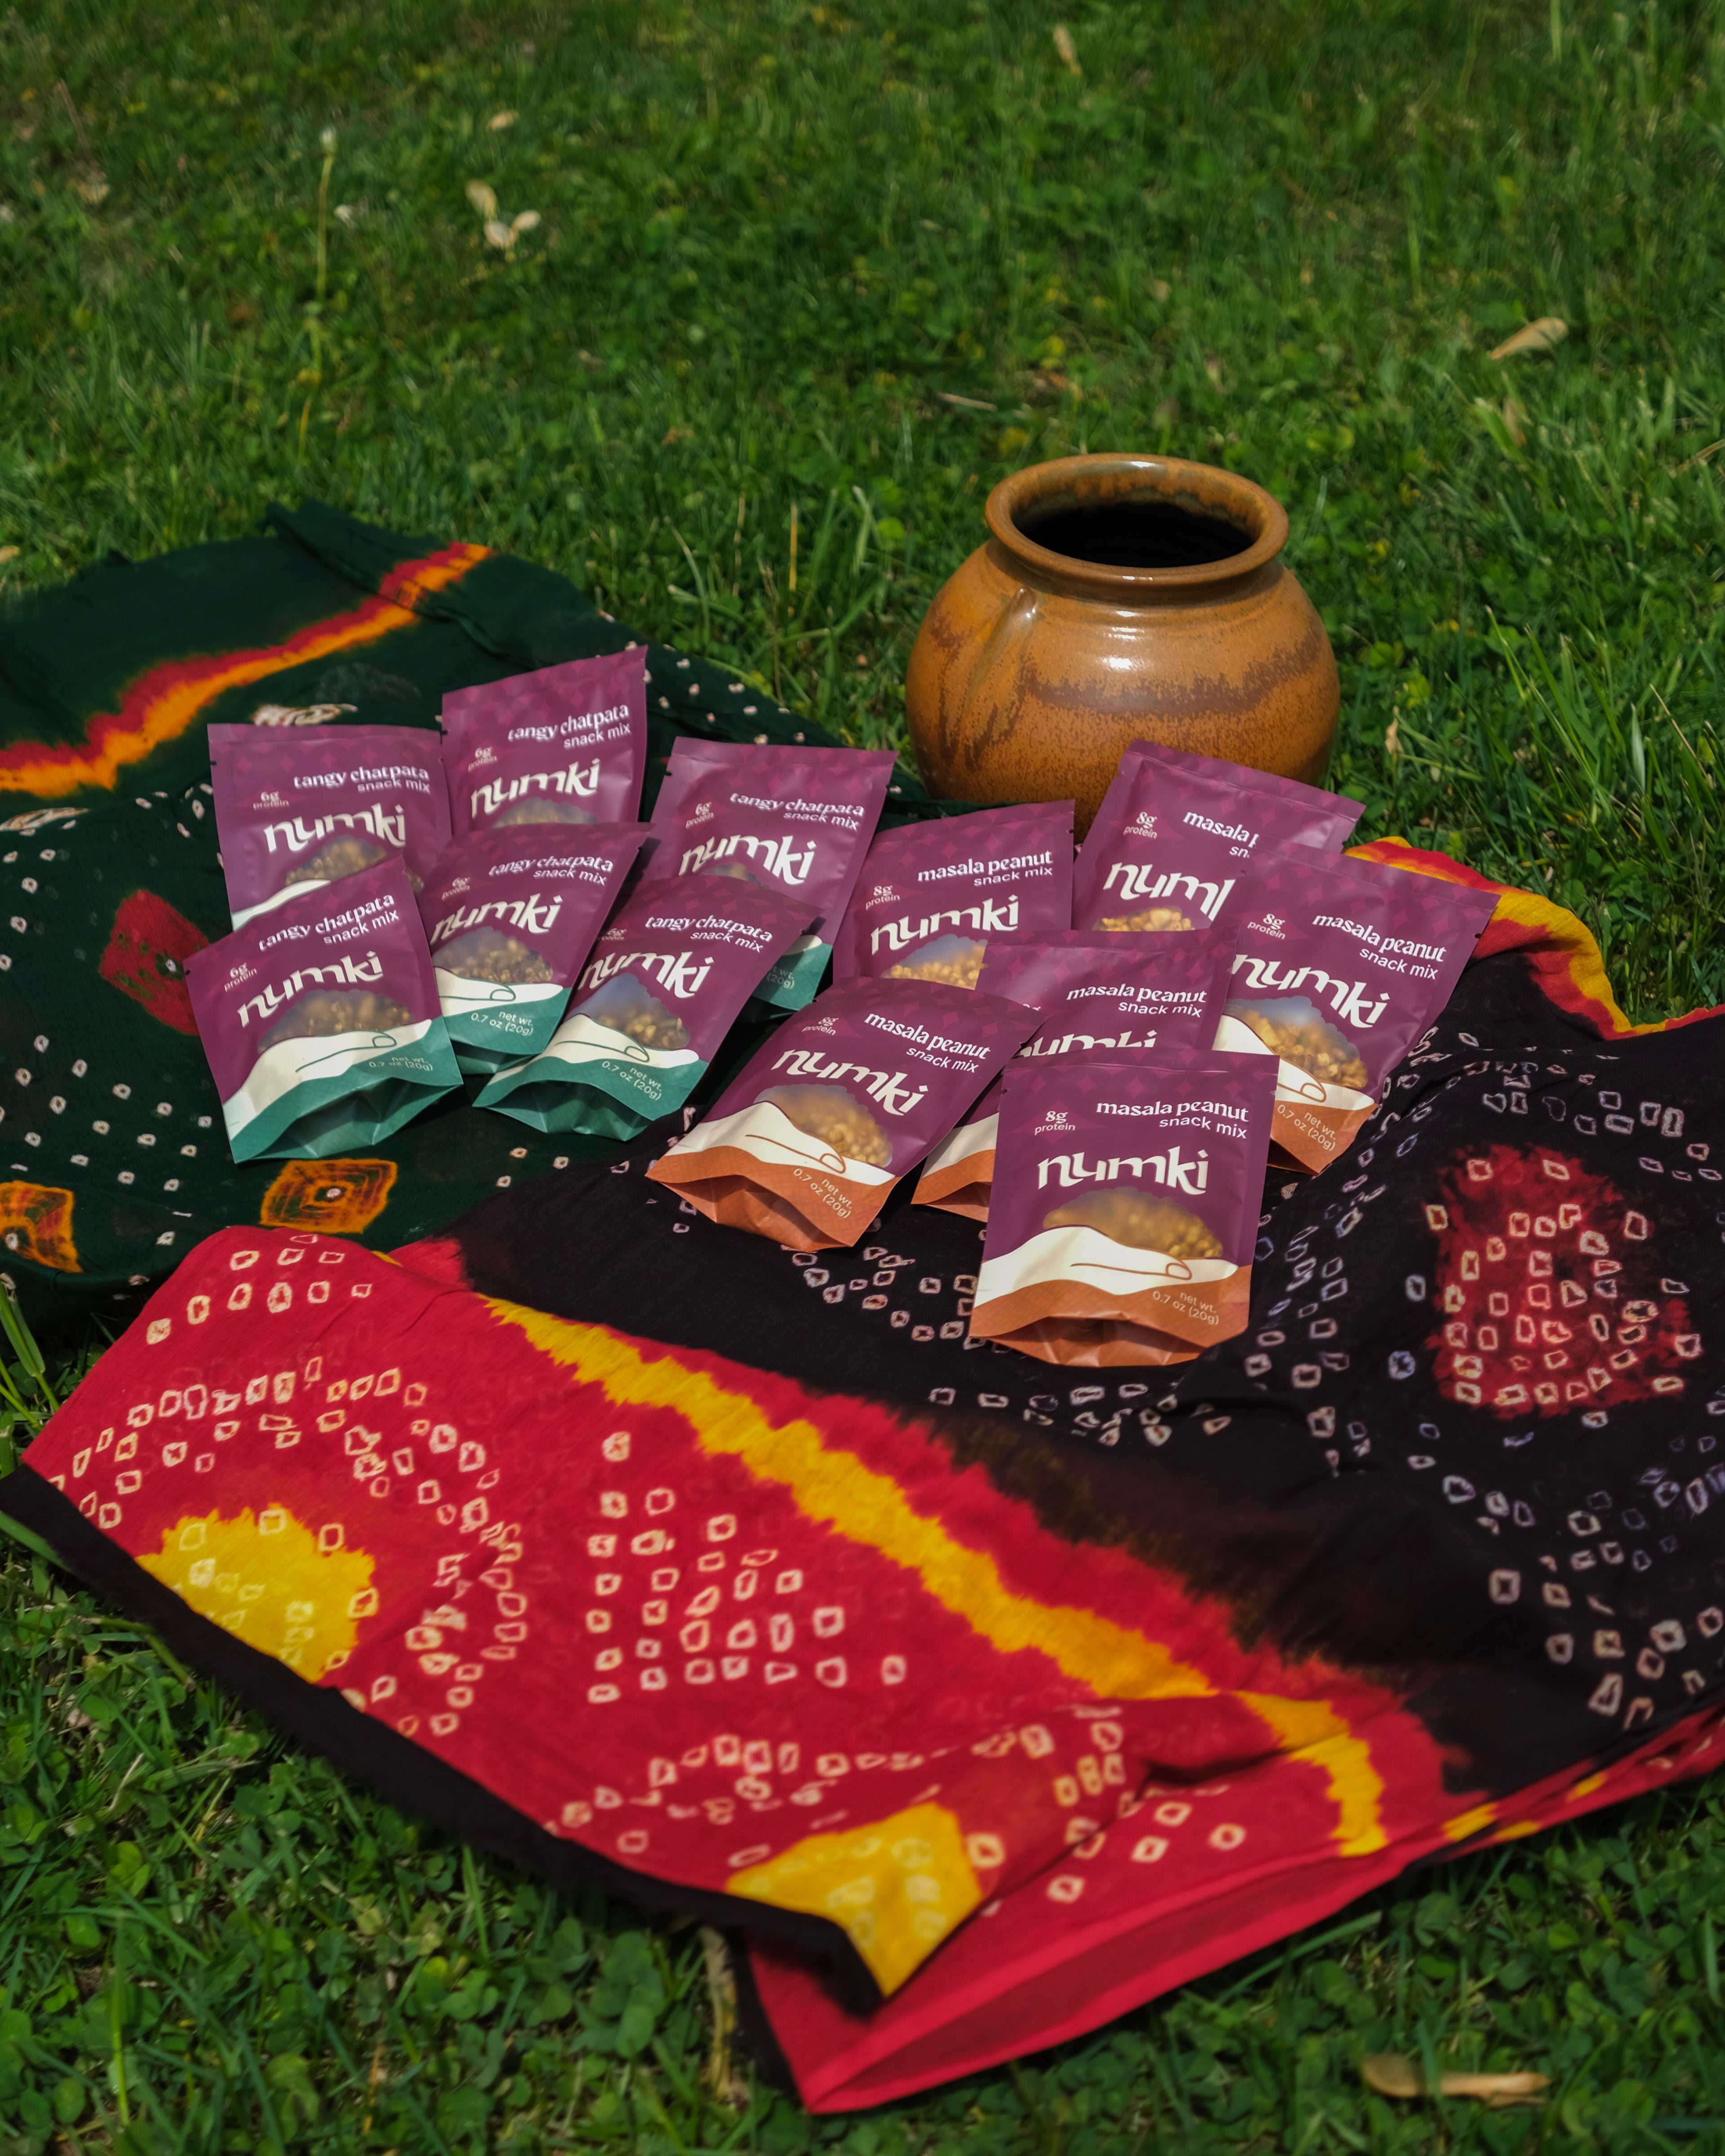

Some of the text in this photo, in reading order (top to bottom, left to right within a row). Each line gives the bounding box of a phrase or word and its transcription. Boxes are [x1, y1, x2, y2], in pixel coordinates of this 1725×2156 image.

[508, 704, 629, 742] tangy chatpata
[563, 723, 631, 749] snack mix
[474, 747, 492, 759] 6g
[294, 765, 429, 788] tangy chatpata
[358, 779, 430, 794] snack mix
[471, 758, 600, 818] numki
[261, 791, 279, 802] 6g
[695, 802, 712, 815] 6g
[730, 792, 864, 816] tangy chatpata
[264, 803, 405, 853] numki
[686, 812, 715, 828] protein
[783, 811, 859, 831] snack mix
[1123, 825, 1157, 839] protein
[1136, 812, 1157, 829] 8g
[1183, 812, 1250, 842] masala
[489, 856, 614, 877] tangy chatpata
[679, 835, 817, 885] numki
[917, 850, 1053, 882] masala peanut
[534, 868, 607, 885] snack mix
[974, 866, 1053, 887] snack mix
[866, 894, 900, 910] protein
[873, 886, 893, 897] 8g
[259, 894, 395, 951] tangy chatpata
[323, 909, 399, 944] snack mix
[430, 893, 563, 945] numki
[645, 915, 773, 942] tangy chatpata
[871, 894, 1019, 955] numki
[1247, 921, 1285, 940] protein
[1263, 914, 1285, 928] 8g
[690, 931, 763, 953] snack mix
[1312, 915, 1446, 962] masala peanut
[230, 962, 248, 978] 6g
[577, 951, 714, 998] numki
[1359, 948, 1438, 980] snack mix
[225, 967, 257, 992] protein
[237, 950, 384, 1028] numki
[1230, 954, 1390, 1028] numki
[1066, 983, 1207, 1003] masala peanut
[499, 1010, 533, 1026] net wt.
[818, 1017, 839, 1025] 8g
[1119, 1002, 1202, 1017] snack mix
[471, 1012, 534, 1036] 0.7 oz (20g)
[802, 1025, 836, 1035] protein
[864, 1013, 991, 1059] masala peanut
[405, 1060, 433, 1071] (20g)
[907, 1047, 979, 1073] snack mix
[602, 1060, 662, 1100] 0.7 oz (20g)
[629, 1066, 662, 1092] net wt.
[771, 1049, 929, 1116] numki
[1045, 1111, 1067, 1123] 8g
[1096, 1101, 1249, 1122] masala peanut
[1035, 1123, 1075, 1135] protein
[1159, 1117, 1247, 1139] snack mix
[1278, 1105, 1336, 1151] 0.7 oz (20g)
[1304, 1110, 1336, 1140] net wt.
[1038, 1146, 1208, 1195] numki
[793, 1168, 851, 1219] 0.7 oz (20g)
[822, 1179, 853, 1209] net wt.
[1153, 1291, 1219, 1325] 0.7 oz (20g)
[1180, 1291, 1217, 1313] net wt.
